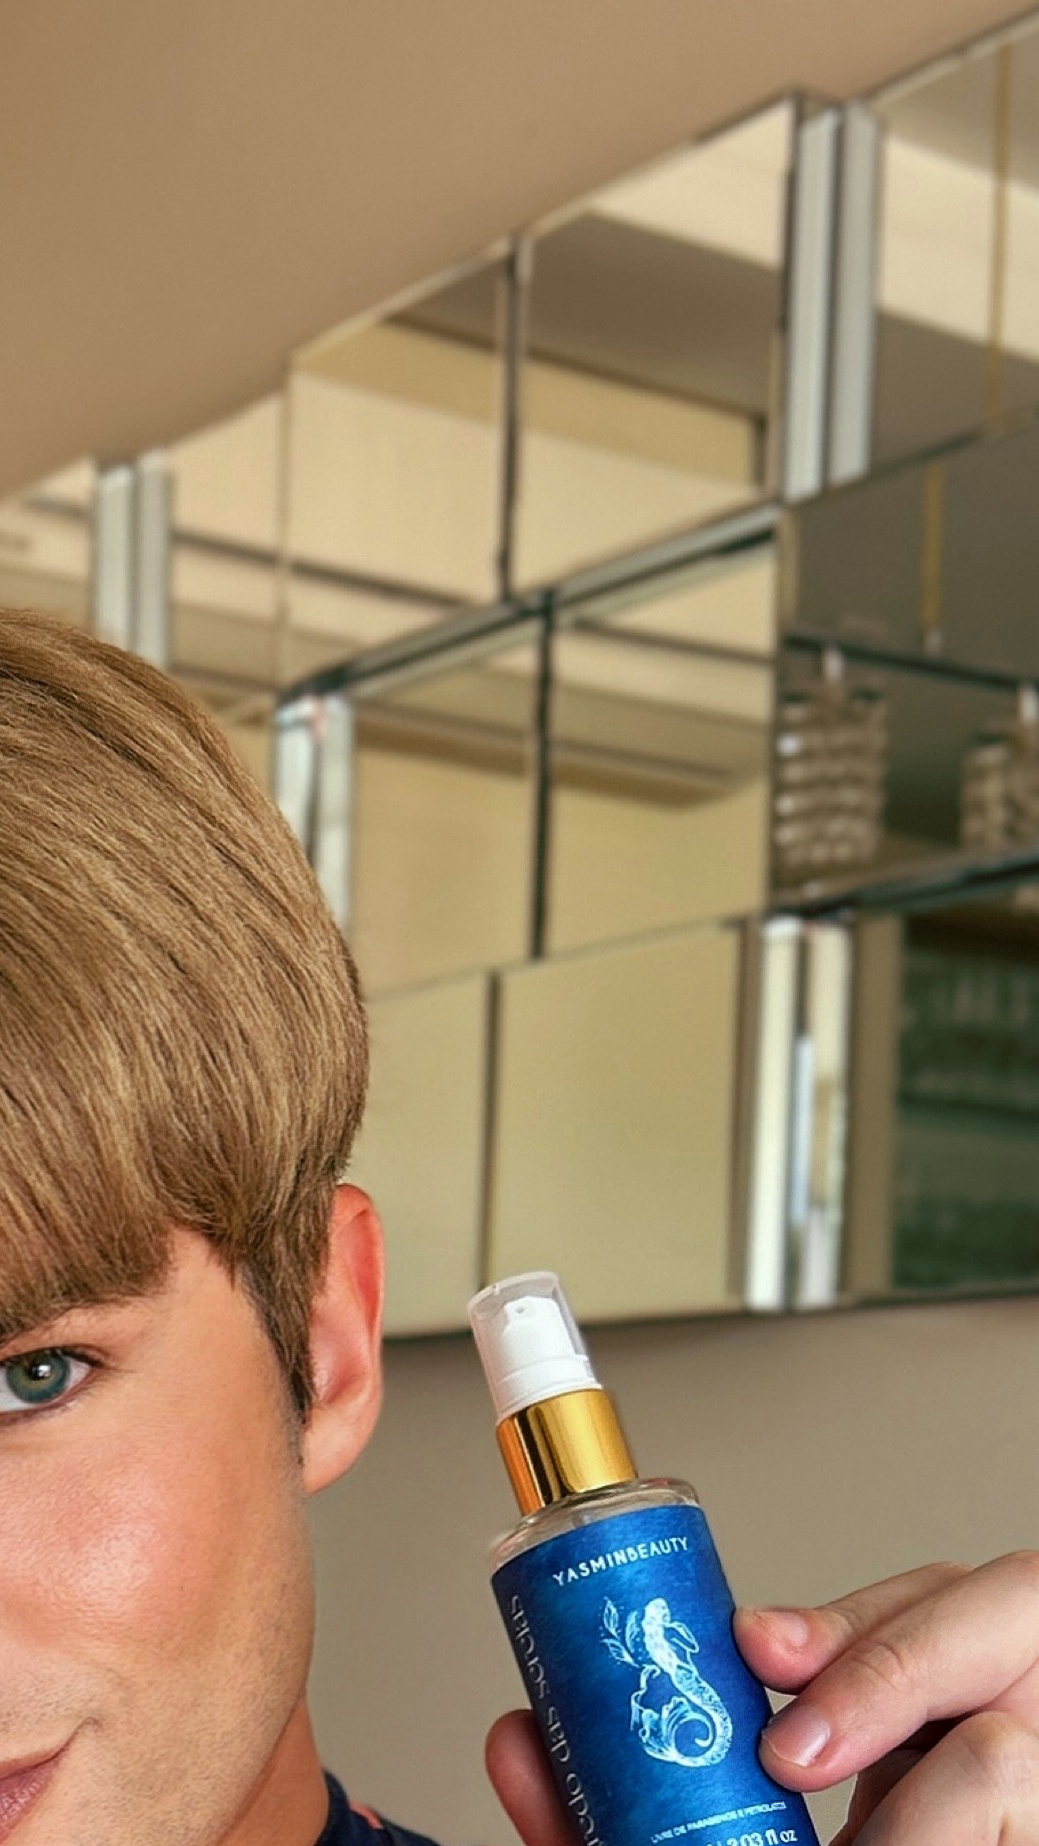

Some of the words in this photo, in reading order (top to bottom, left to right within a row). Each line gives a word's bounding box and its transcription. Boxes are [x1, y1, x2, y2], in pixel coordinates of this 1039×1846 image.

[552, 1536, 688, 1586] YASMINBEAUTY
[548, 1706, 570, 1763] das
[765, 1828, 779, 1846] fl
[780, 1829, 798, 1843] oz
